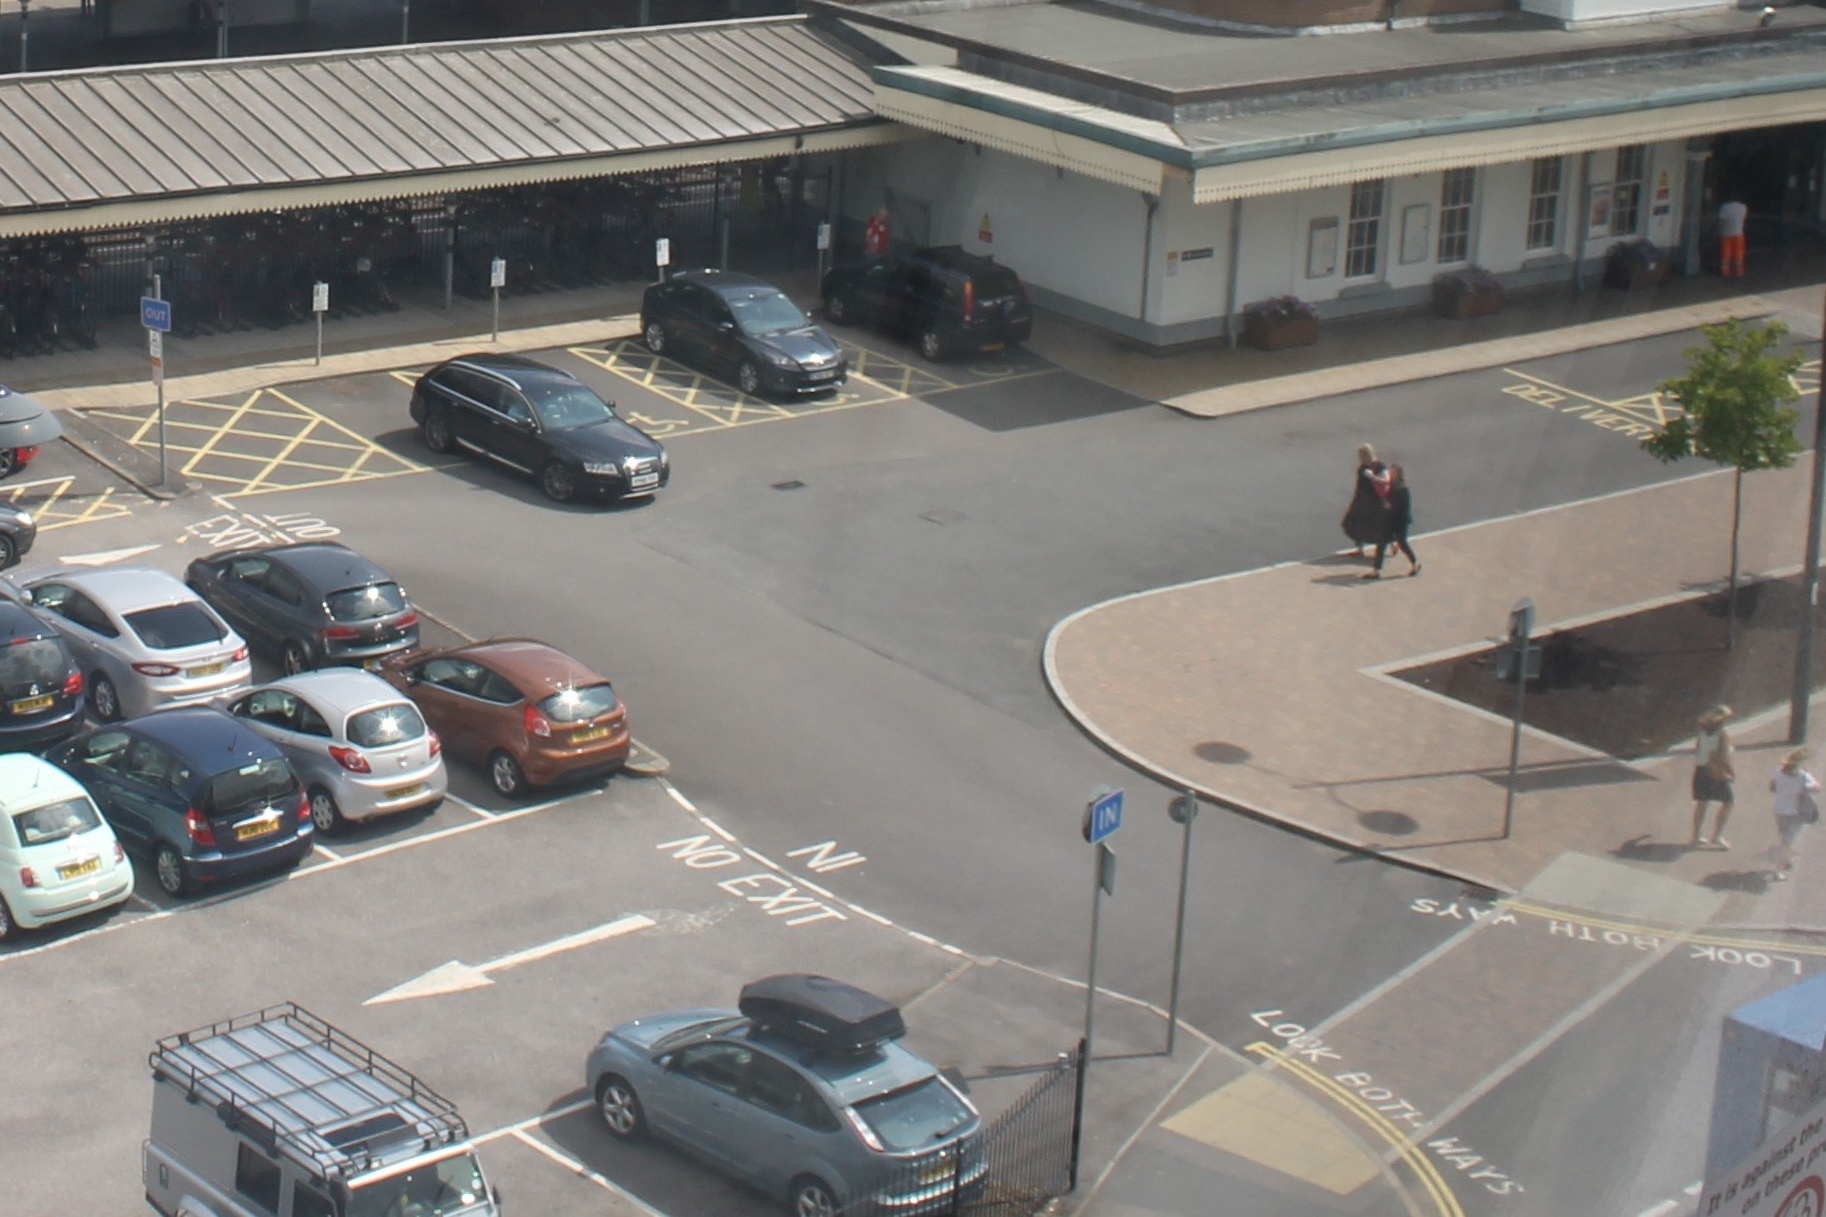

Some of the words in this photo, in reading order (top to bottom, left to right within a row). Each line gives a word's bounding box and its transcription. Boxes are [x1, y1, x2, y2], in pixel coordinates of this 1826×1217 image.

[145, 307, 167, 322] OUT
[1501, 383, 1657, 442] DELIVER
[184, 514, 272, 549] EXIT
[261, 511, 341, 539] OUT
[1099, 802, 1118, 832] IN
[656, 835, 741, 868] NO
[785, 841, 867, 873] IN
[716, 873, 848, 926] EXIT
[1410, 897, 1517, 925] WAYS
[1549, 920, 1662, 952] BOTH
[1690, 944, 1803, 975] LOOK
[1250, 1009, 1342, 1063] LOOK
[1334, 1071, 1433, 1128] BOTH
[1427, 1136, 1525, 1195] WAYS
[1741, 1136, 1797, 1190] against
[1799, 1118, 1824, 1146] the
[1764, 1157, 1806, 1198] these
